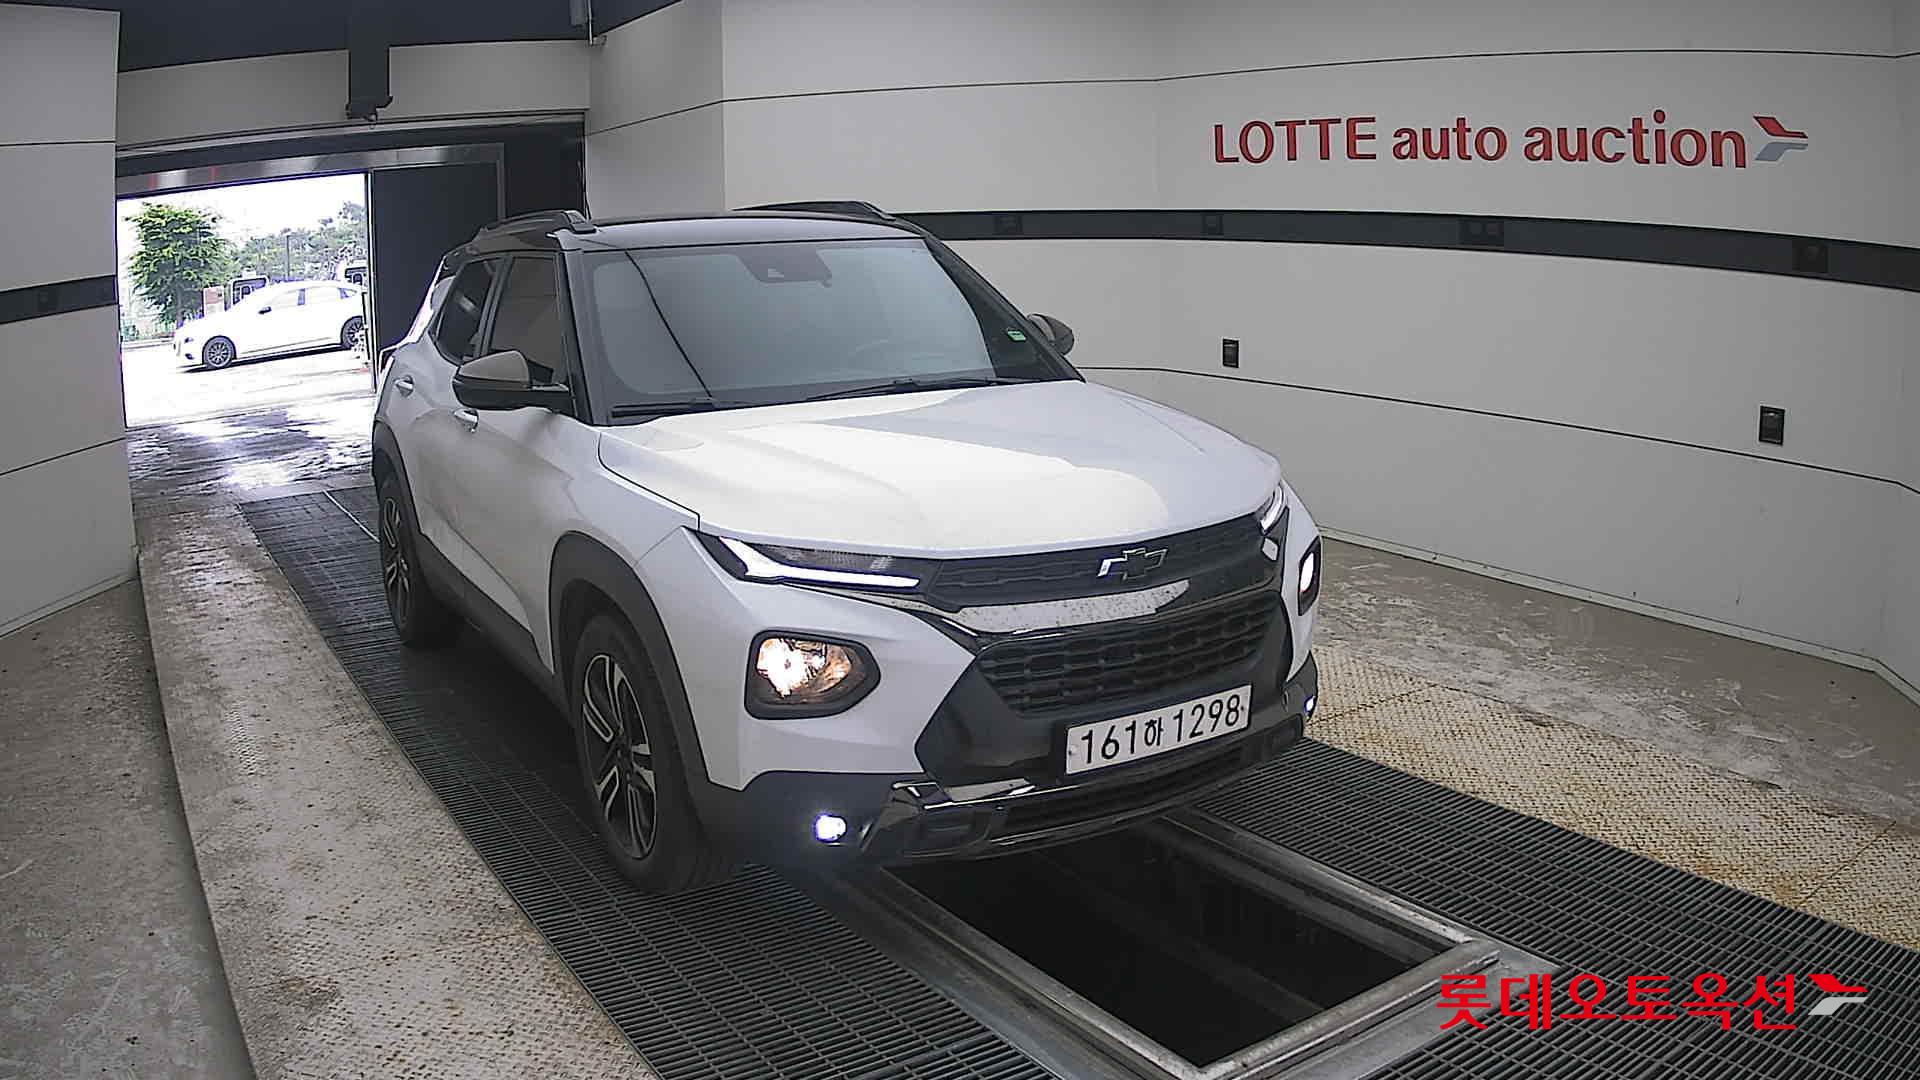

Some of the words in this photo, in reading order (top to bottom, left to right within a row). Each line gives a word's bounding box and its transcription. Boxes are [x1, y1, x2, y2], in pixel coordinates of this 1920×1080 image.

[1214, 116, 1377, 164] LOTTE
[1393, 117, 1507, 161] auto
[1523, 109, 1748, 169] auction
[1174, 694, 1241, 742] 1298
